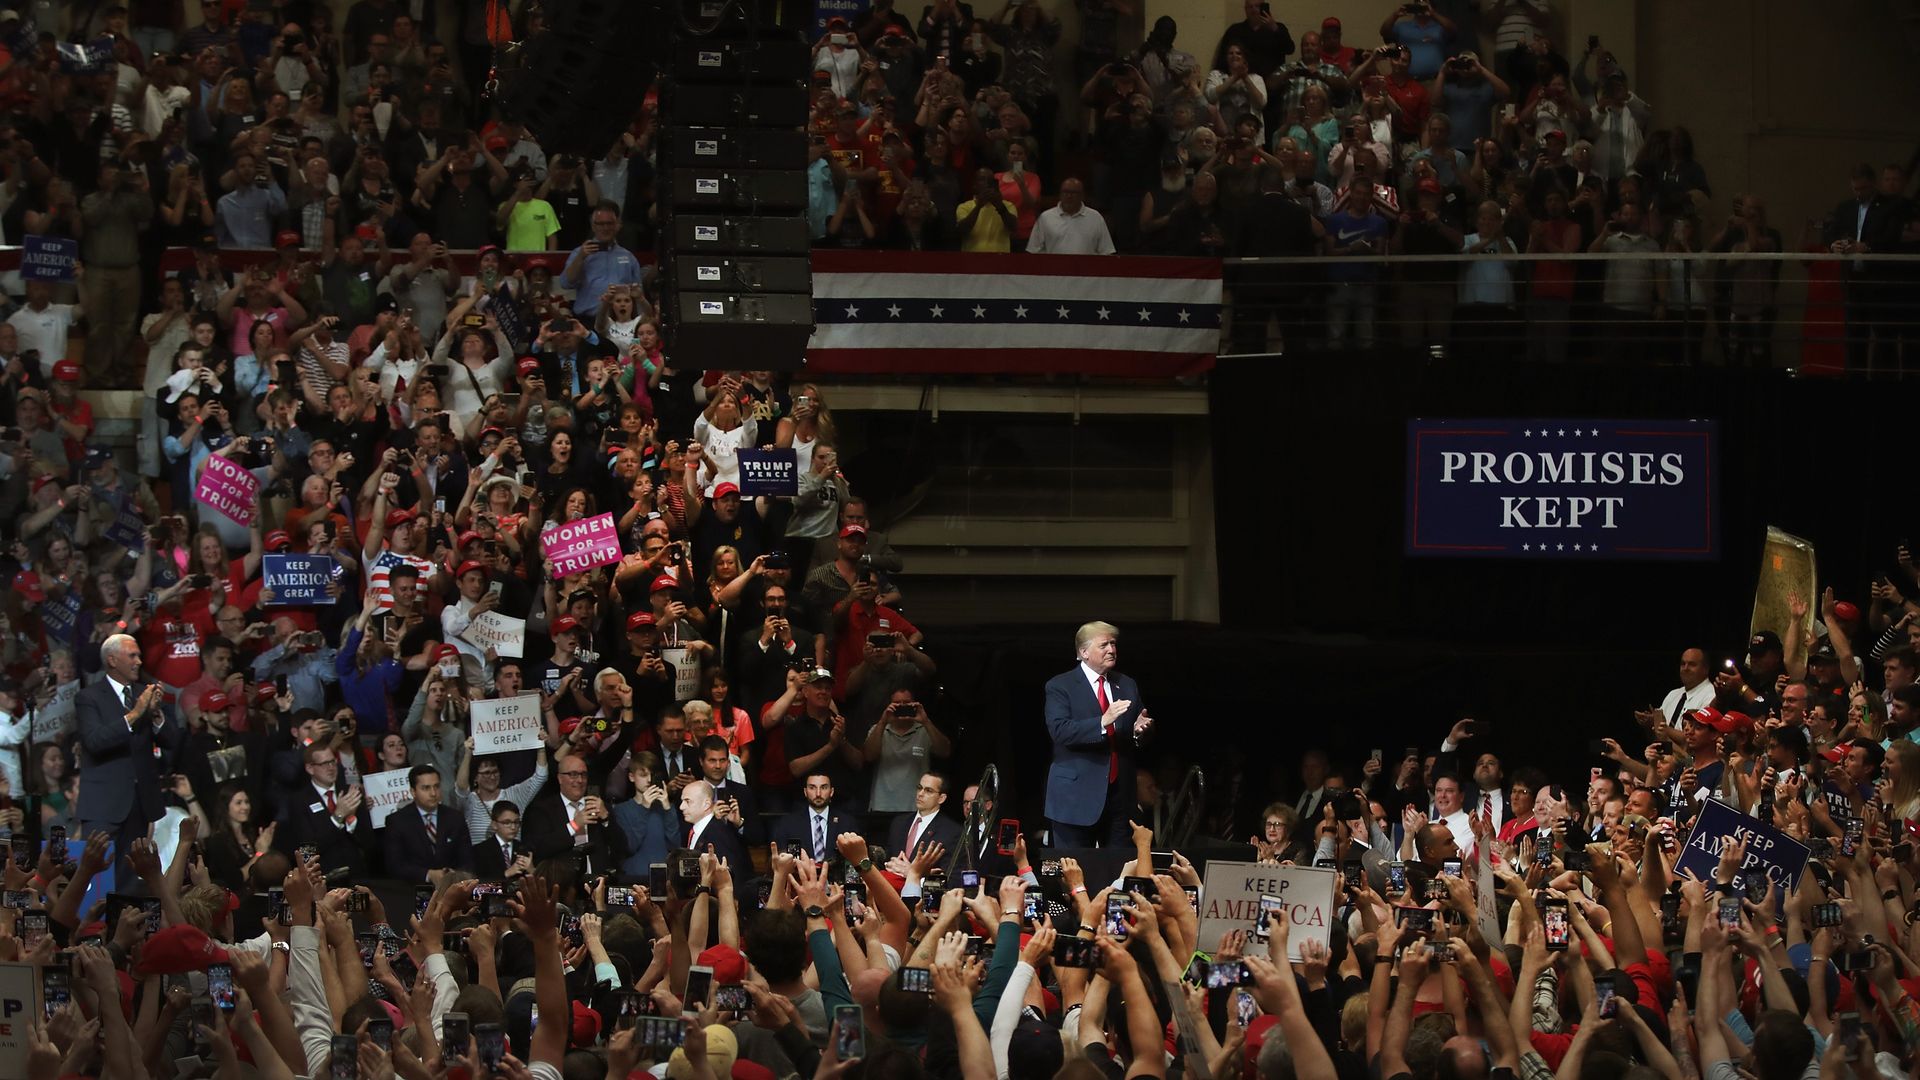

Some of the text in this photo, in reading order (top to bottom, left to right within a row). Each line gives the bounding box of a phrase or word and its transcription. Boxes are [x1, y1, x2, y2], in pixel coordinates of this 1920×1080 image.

[818, 0, 859, 10] Middle
[41, 242, 62, 252] KEEP
[35, 266, 62, 277] GREAT
[208, 456, 256, 492] WOME
[742, 461, 793, 471] TRUMP
[1439, 450, 1685, 486] PROMISES
[220, 482, 243, 500] FOR
[200, 485, 249, 520] TRUMP
[1499, 496, 1625, 529] KEPT
[542, 515, 615, 547] WOMEN
[567, 538, 595, 554] FOR
[285, 561, 312, 571] KEEP
[553, 546, 618, 574] TRUMP
[268, 572, 332, 587] AMERICA
[283, 588, 317, 599] GREAT
[470, 621, 521, 645] MERICA
[495, 705, 519, 716] KEEP
[475, 716, 539, 735] AMERICA
[493, 733, 523, 745] GREAT
[372, 790, 413, 808] AMER
[1826, 791, 1853, 809] TRU
[1830, 805, 1854, 818] PEN
[1690, 830, 1794, 889] AMRICA
[1244, 878, 1291, 894] KEEP
[1204, 899, 1325, 928] AMEICA
